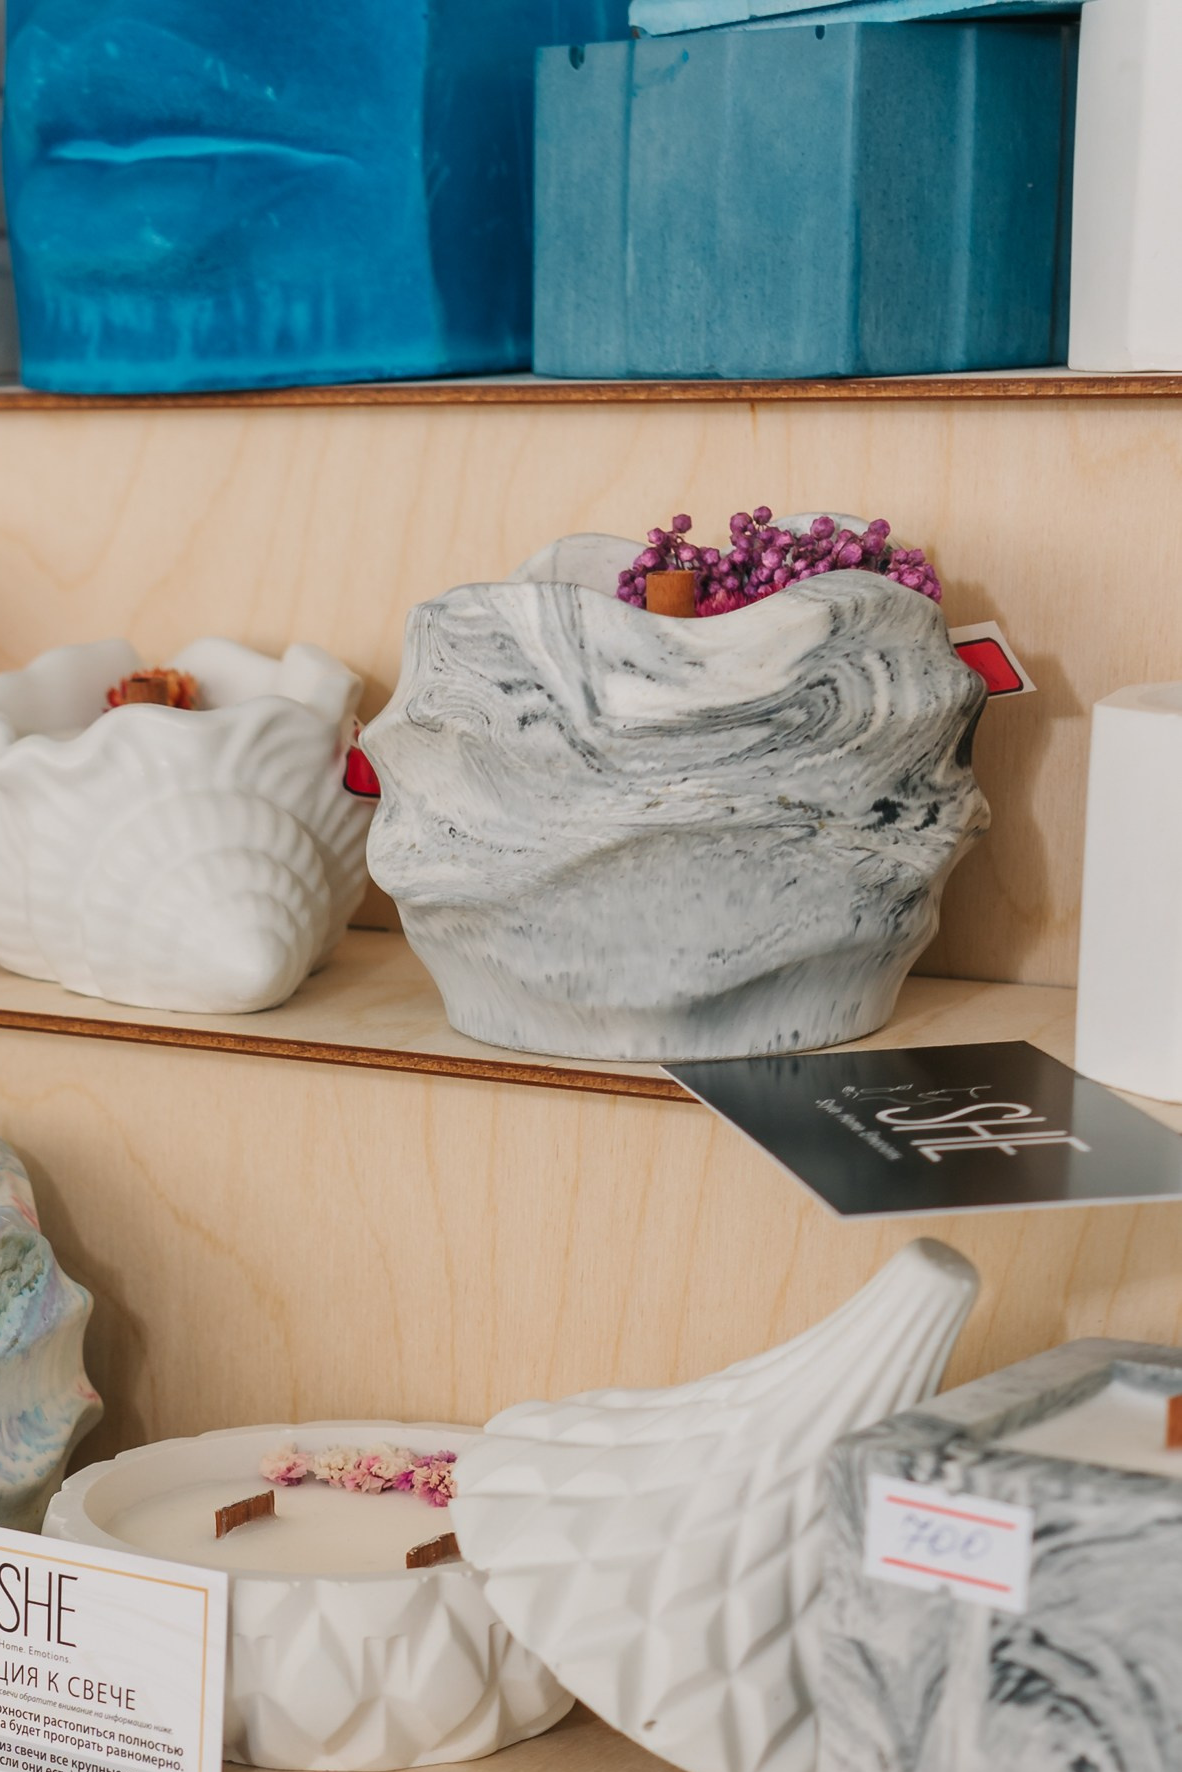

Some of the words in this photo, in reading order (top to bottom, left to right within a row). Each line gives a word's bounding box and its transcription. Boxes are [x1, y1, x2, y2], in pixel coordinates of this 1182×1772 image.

[875, 1102, 1093, 1163] SHE
[899, 1512, 994, 1563] 700
[28, 1645, 72, 1664] Emotions.
[67, 1676, 136, 1711] СВЕЧЕ
[0, 1741, 13, 1753] из
[14, 1745, 48, 1762] свечи
[49, 1753, 69, 1767] все
[8, 1718, 42, 1738] будет
[43, 1729, 104, 1753] прогорать
[105, 1744, 184, 1772] равномерно.
[43, 1715, 116, 1741] растопиться
[118, 1733, 184, 1757] полностью
